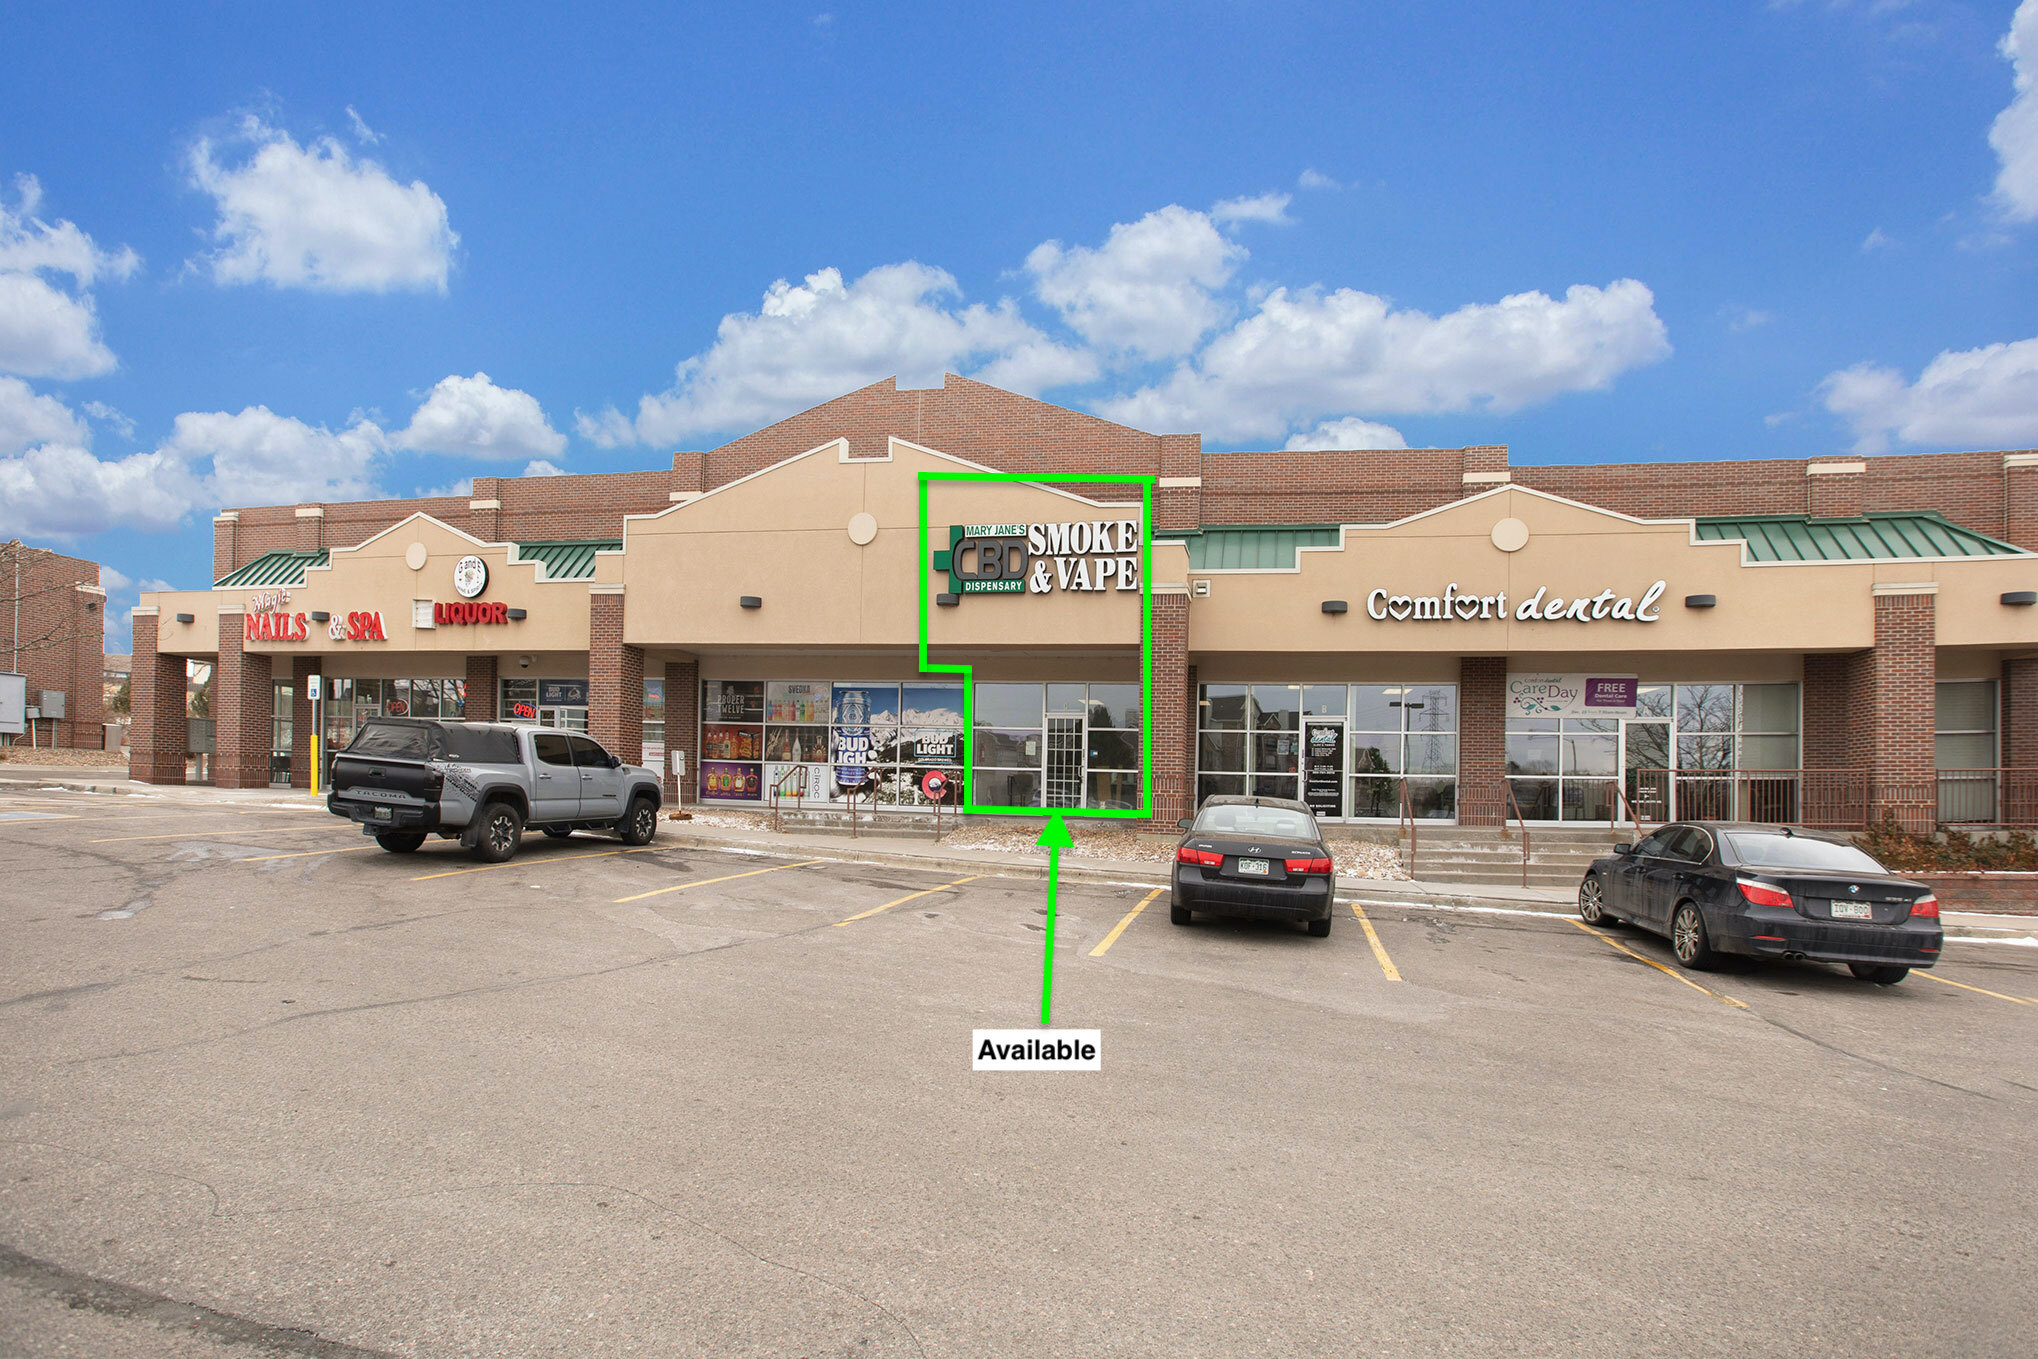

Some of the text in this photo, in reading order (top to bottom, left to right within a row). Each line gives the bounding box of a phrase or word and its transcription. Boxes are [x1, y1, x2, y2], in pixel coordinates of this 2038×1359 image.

[966, 524, 1025, 536] MARY JANE'S
[1028, 520, 1138, 556] SMOKE
[953, 540, 1029, 580] CBD
[1029, 557, 1138, 593] & VAPE
[965, 581, 1023, 591] DISPENSARY
[252, 588, 291, 614] Magic
[1367, 580, 1666, 622] Comfort dental
[434, 602, 508, 626] LIQUOR
[245, 611, 388, 640] NAILS & SPA
[1510, 680, 1578, 700] Care Day
[1597, 683, 1626, 693] FREE
[388, 701, 404, 712] OPEN
[717, 695, 745, 704] PROPER
[513, 703, 536, 718] OPEN
[717, 704, 745, 714] TWELVE
[838, 737, 869, 751] BUD
[922, 734, 949, 744] BUD
[916, 744, 954, 755] LIGHT
[355, 790, 406, 799] TACOMA
